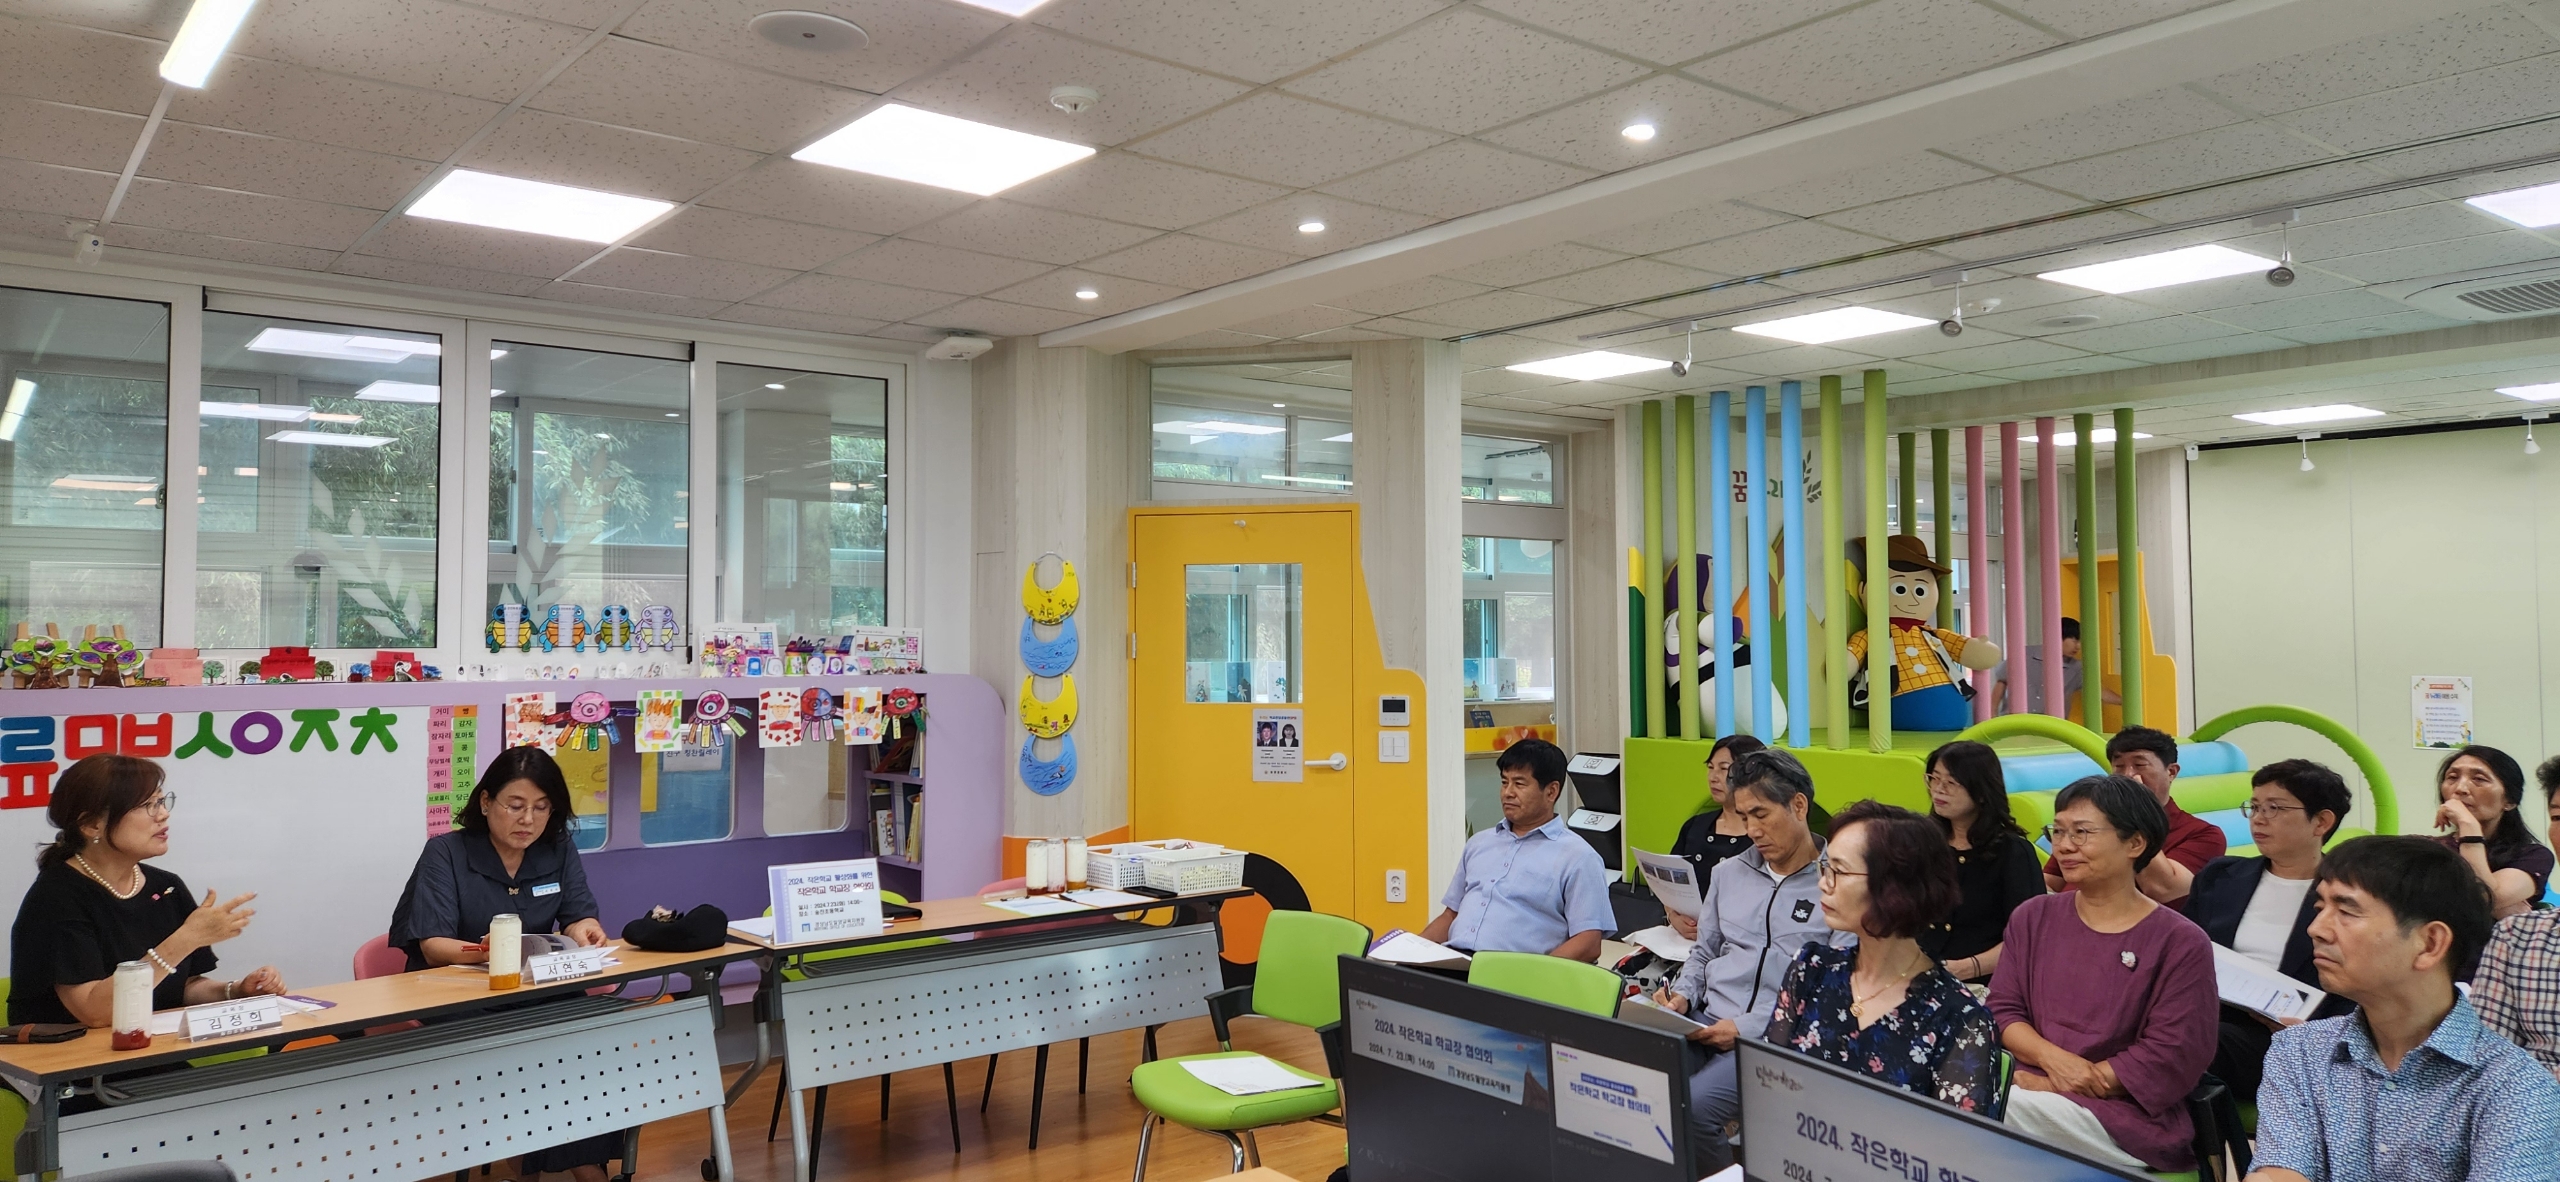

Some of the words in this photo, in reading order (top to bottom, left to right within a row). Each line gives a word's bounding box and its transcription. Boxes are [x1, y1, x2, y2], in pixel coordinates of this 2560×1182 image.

[459, 719, 472, 727] 감자
[431, 732, 451, 740] 잠자리
[455, 731, 474, 739] 토마토
[457, 768, 470, 776] 오이
[808, 875, 832, 883] 작은학교
[797, 886, 826, 896] 작은학교
[1374, 1018, 1396, 1036] 2024.
[1399, 1025, 1433, 1046] 작은학교
[1436, 1036, 1462, 1056] 학교장
[1465, 1044, 1493, 1064] 협의회
[1570, 1081, 1600, 1100] 작은학교
[1627, 1098, 1651, 1115] 협의회
[1796, 1112, 1844, 1151] 2024.
[1850, 1131, 1929, 1182] 작은학교
